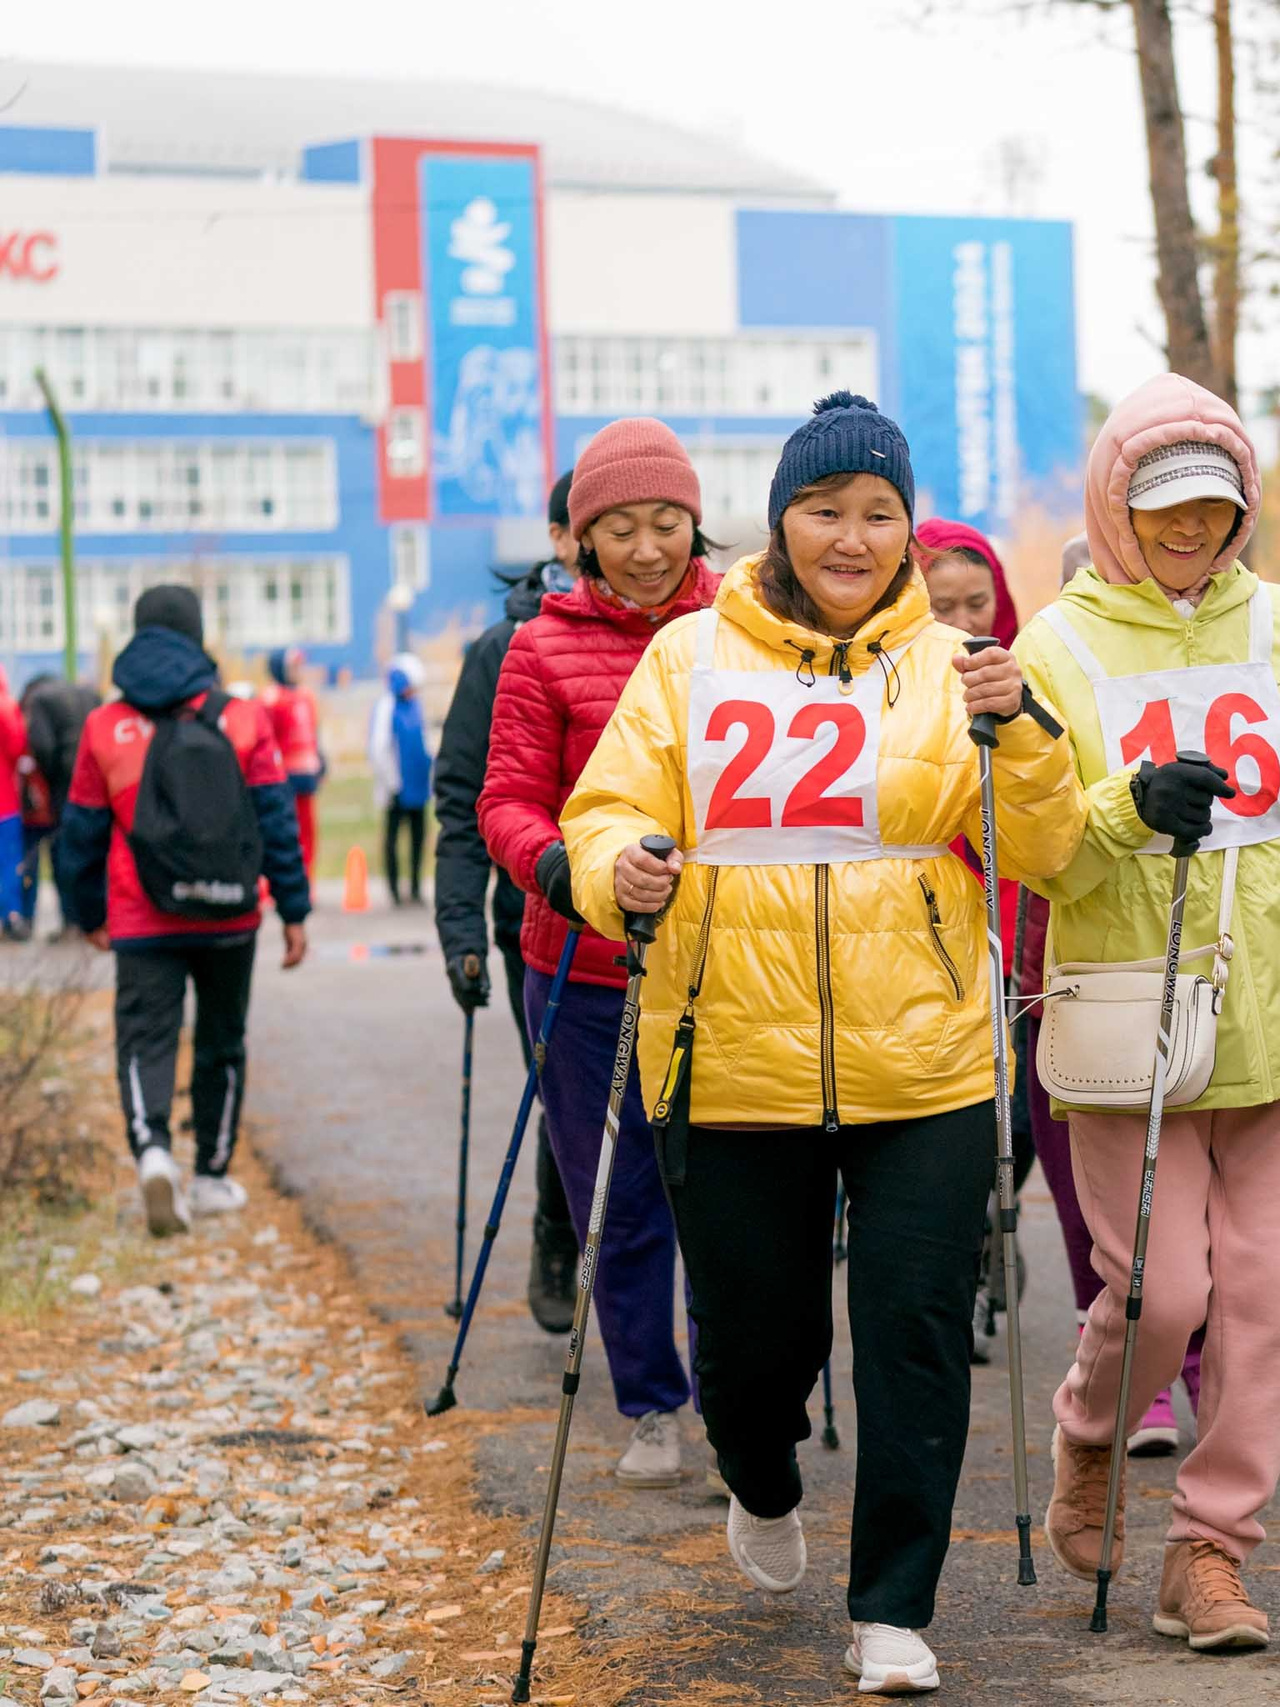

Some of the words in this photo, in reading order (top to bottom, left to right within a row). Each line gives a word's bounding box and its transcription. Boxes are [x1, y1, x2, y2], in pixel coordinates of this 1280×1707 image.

[704, 699, 867, 831] 22
[1163, 919, 1183, 1017] LONGWAY
[610, 999, 637, 1097] LONGWAY
